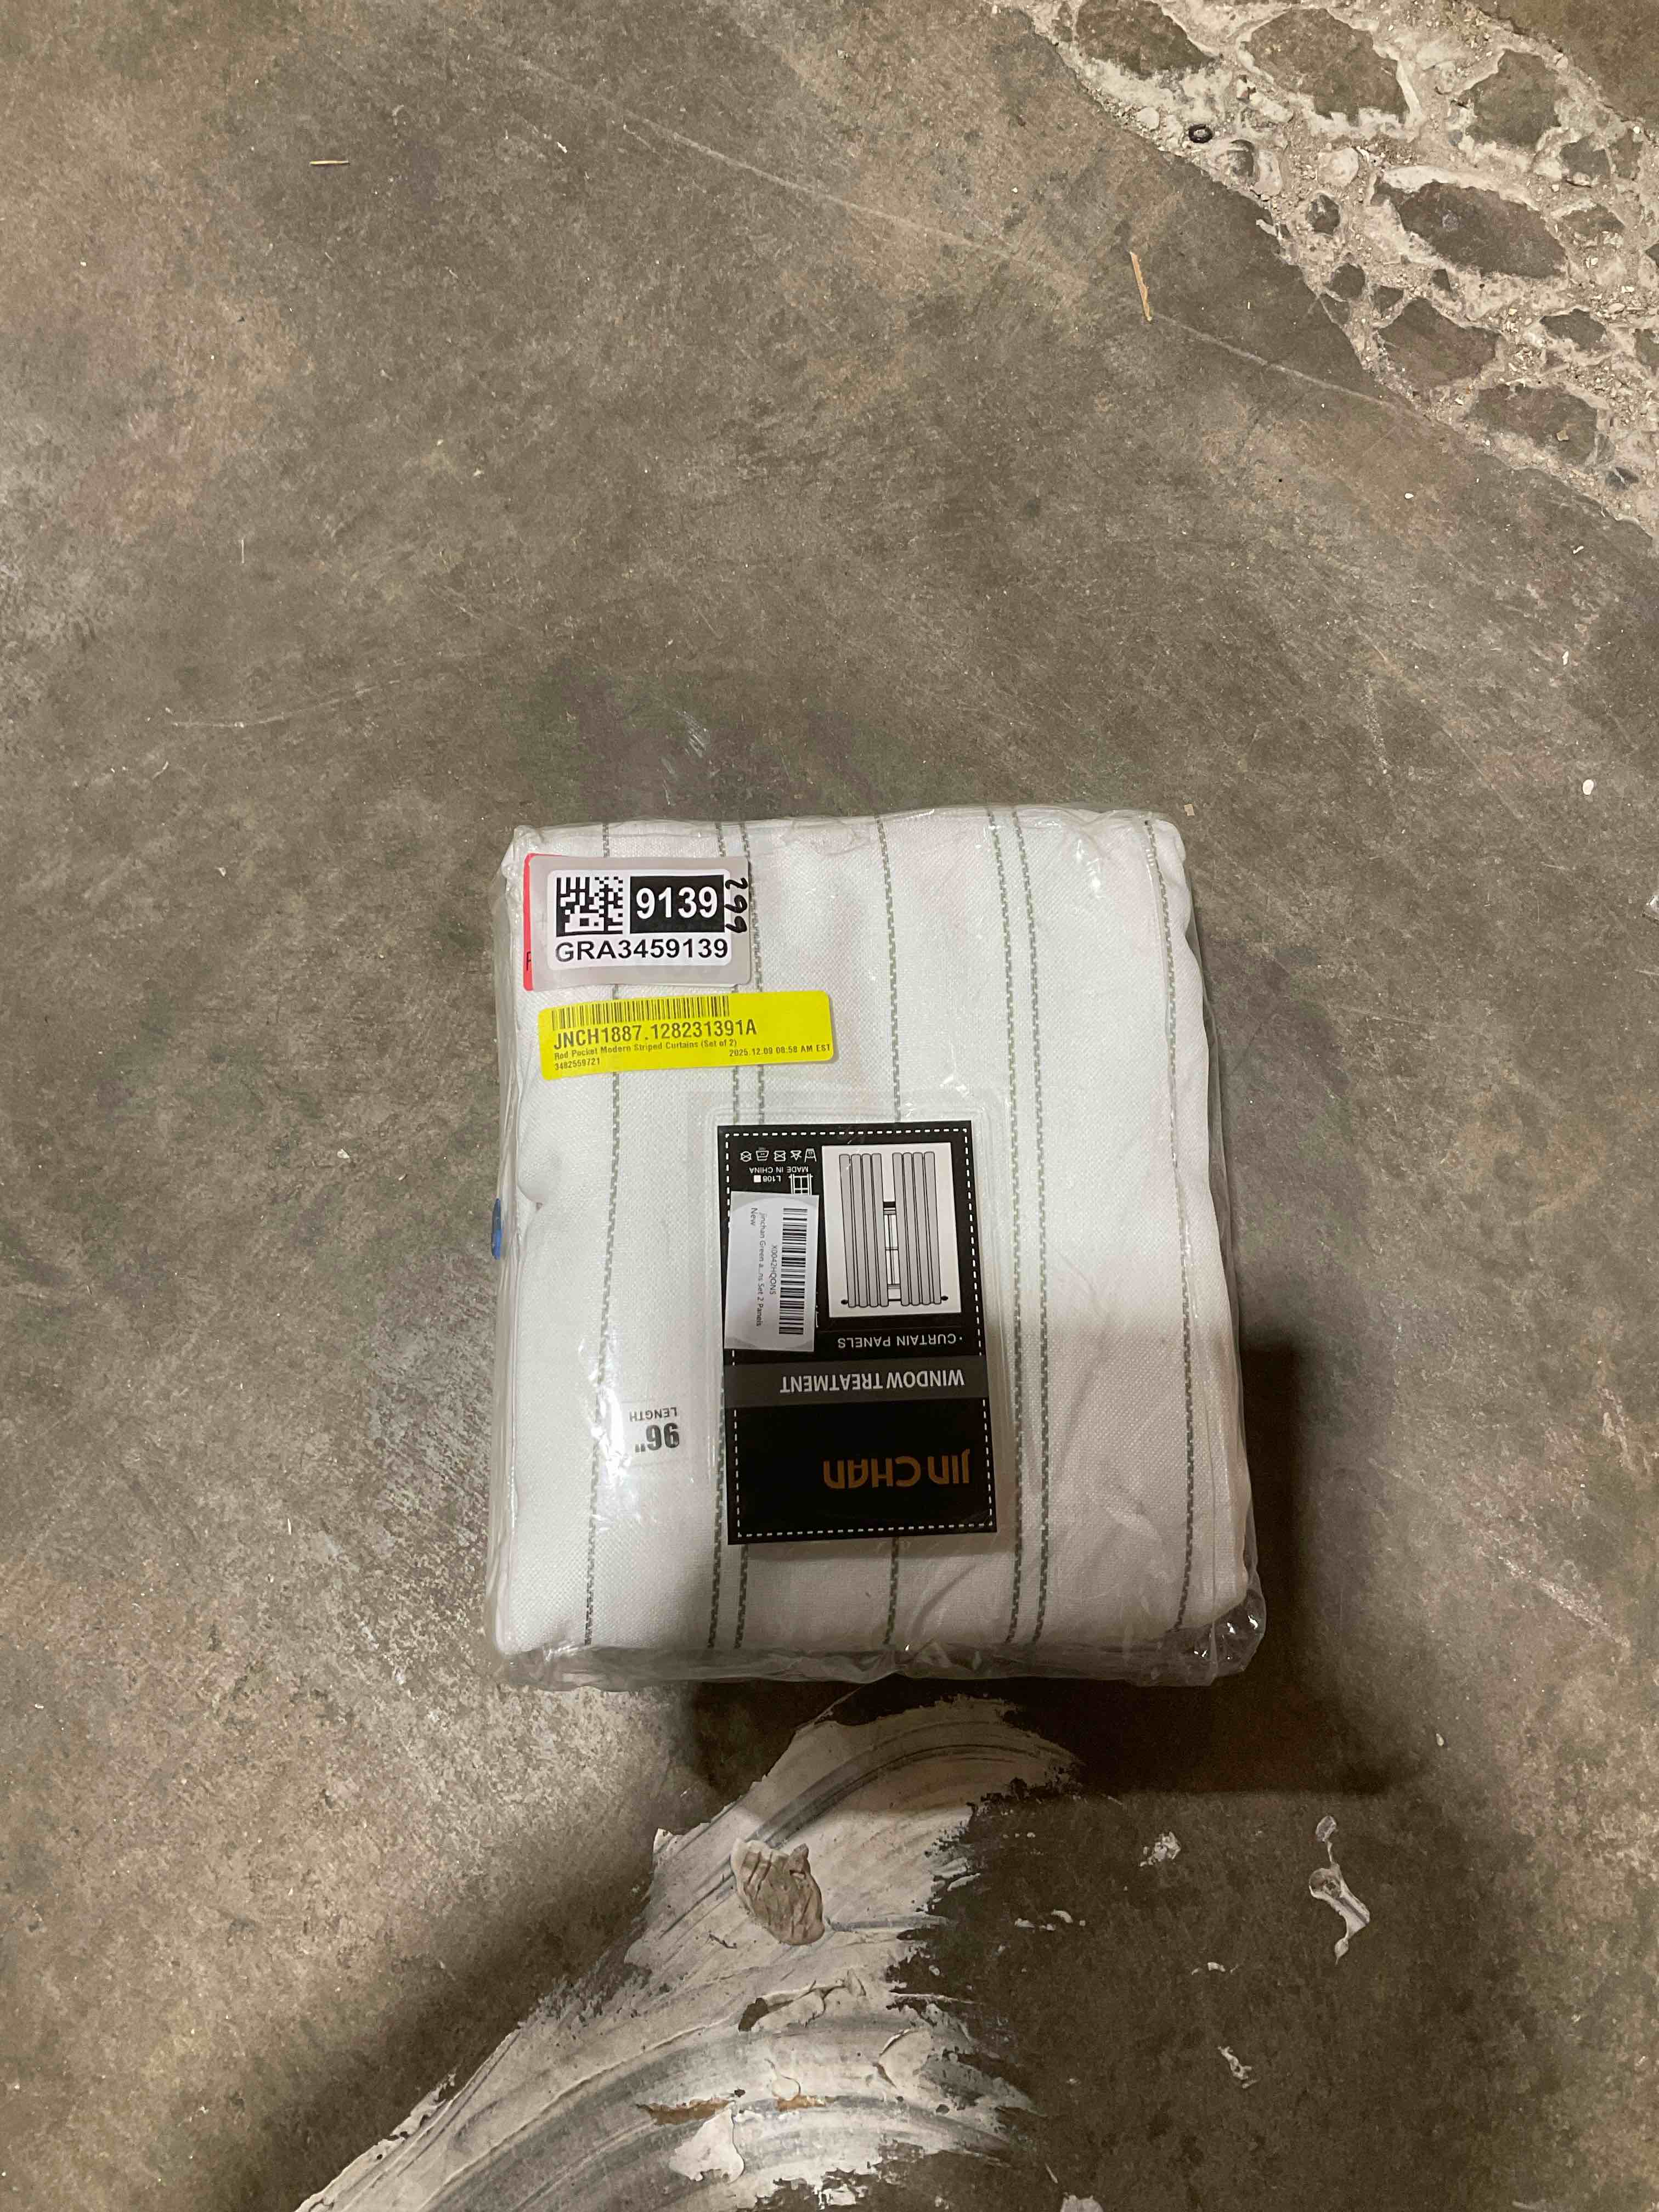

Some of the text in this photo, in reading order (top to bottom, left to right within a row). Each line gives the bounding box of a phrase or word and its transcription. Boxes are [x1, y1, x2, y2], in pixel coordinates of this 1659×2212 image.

[636, 887, 718, 919] 9139
[724, 877, 748, 933] 299
[556, 939, 728, 962] GRA3459139
[554, 1019, 757, 1049] JNCH1887.128231391A
[555, 1050, 568, 1060] Rod
[572, 1045, 598, 1057] Pocket
[601, 1043, 631, 1054] Modern
[634, 1041, 663, 1052] Striped
[665, 1040, 698, 1049] Curtains
[701, 1040, 717, 1048] (Set
[729, 1039, 737, 1047] 2)
[801, 1045, 812, 1053] AM
[816, 1043, 830, 1052] EST
[838, 1333, 956, 1348] CURTAIN PANELS
[780, 1369, 965, 1393] WINDOW TREATMENT
[629, 1407, 677, 1422] LENGTH
[635, 1423, 679, 1453] 96"
